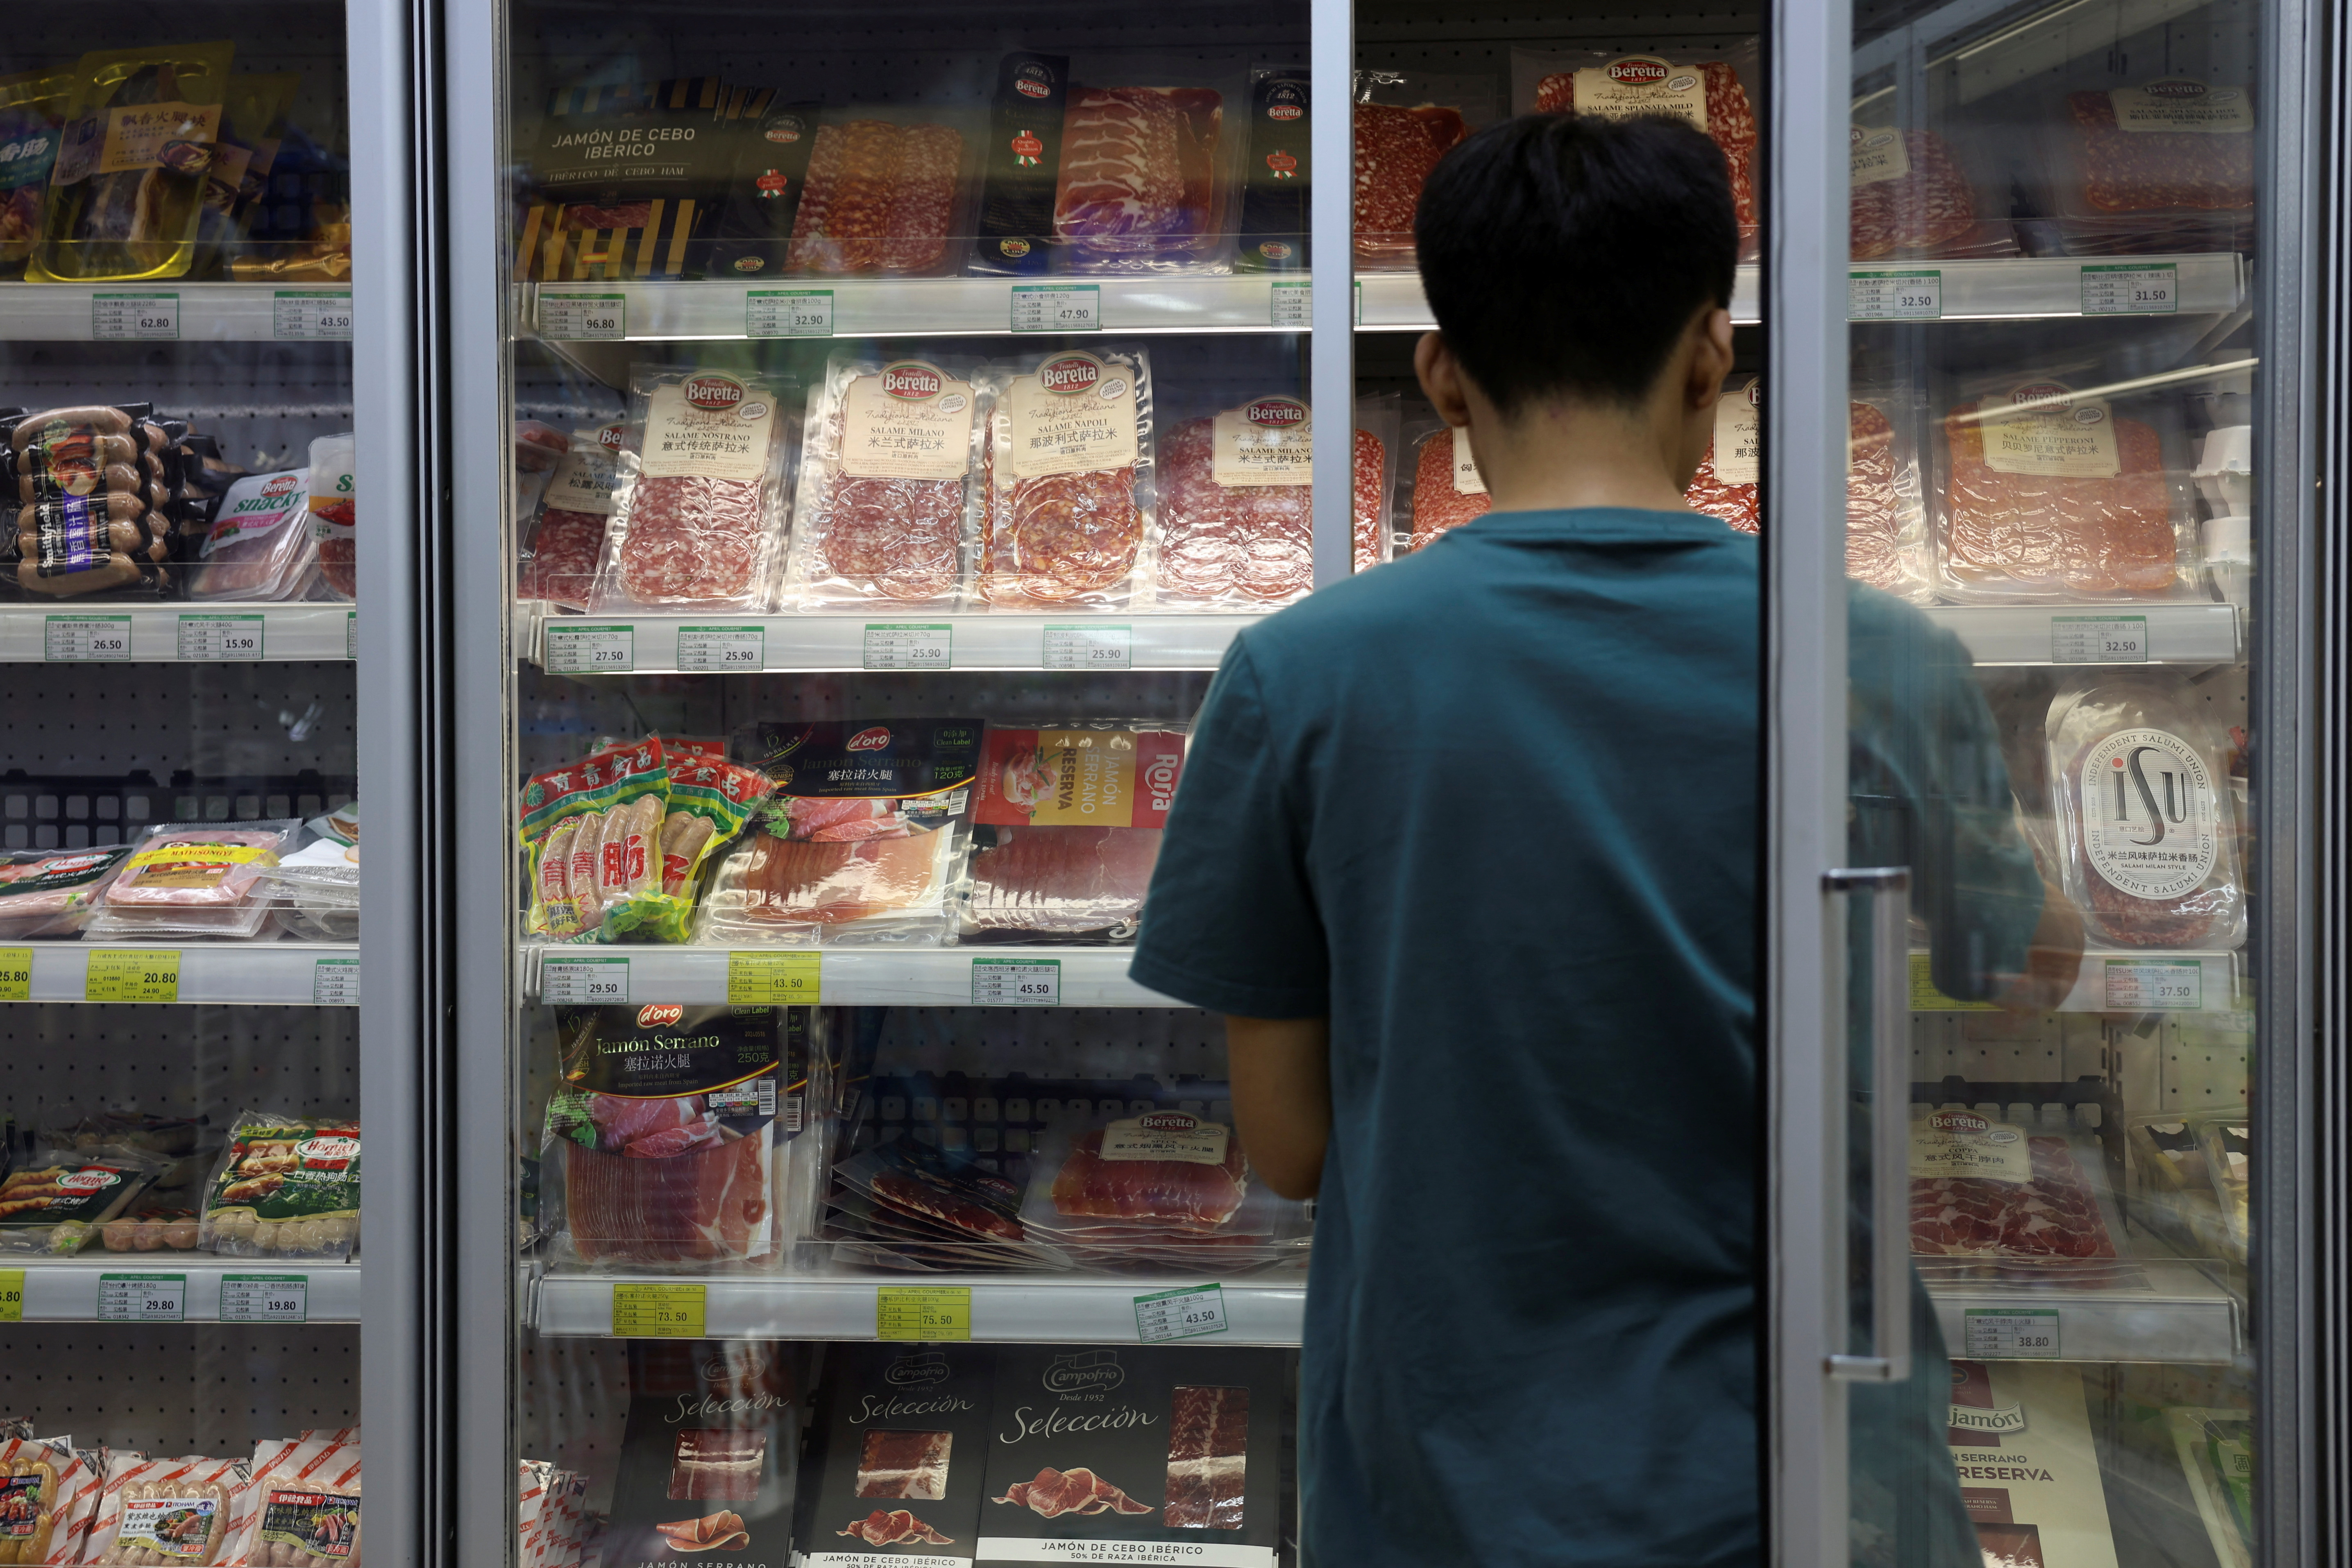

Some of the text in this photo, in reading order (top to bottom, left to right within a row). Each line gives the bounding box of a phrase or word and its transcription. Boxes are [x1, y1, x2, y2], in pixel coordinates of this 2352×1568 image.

[1610, 66, 1666, 78] Beretta
[1016, 80, 1049, 95] Beretta
[2146, 84, 2206, 95] Beretta
[1269, 108, 1301, 116] Beretta
[552, 128, 696, 148] JAMÓN DE CEBO
[766, 131, 800, 141] Beretta
[585, 141, 655, 159] IBÉRICO
[625, 167, 655, 176] CEBO
[661, 167, 684, 176] HAM
[2135, 290, 2166, 300] 31.50
[1901, 297, 1931, 306] 32.50
[795, 315, 823, 325] 32.90
[1060, 310, 1089, 319] 47.90
[141, 319, 168, 328] 62.80
[321, 317, 349, 326] 43.50
[587, 319, 615, 329] 96.80
[1043, 366, 1097, 387] Beretta
[885, 373, 939, 392] Beretta
[688, 383, 740, 401] Beretta
[1250, 407, 1304, 420] Beretta
[1038, 418, 1107, 434] SALAME NAPOLI
[702, 433, 750, 442] NOSTRANO
[870, 427, 944, 437] SALAME MILANO
[868, 436, 945, 451] 米兰式萨拉米
[1030, 428, 1118, 449] 那波利式萨拉米
[2003, 433, 2040, 443] SALAME
[661, 440, 750, 454] 意式传统萨拉米
[2002, 440, 2099, 455] 贝贝罗尼意式萨拉米
[1238, 454, 1312, 464] 米兰式萨拉米
[262, 479, 296, 494] Beretta
[234, 491, 307, 513] snacky
[40, 502, 57, 568] Smithfield
[93, 640, 121, 649] 26.50
[225, 639, 253, 648] 15.90
[2105, 642, 2136, 652] 32.50
[596, 652, 623, 661] 27.50
[726, 651, 753, 660] 25.90
[913, 648, 941, 658] 25.90
[1093, 650, 1121, 658] 25.90
[2089, 735, 2205, 790] INDEPENDENT SALUMI UNION
[556, 745, 652, 793] 育青食品
[827, 768, 893, 781] 塞拉诺火腿
[934, 770, 964, 779] 120克
[990, 761, 999, 777] Ready
[1057, 748, 1077, 810] RESERVA
[1080, 746, 1100, 814] SERRANO
[1102, 755, 1122, 805] JAMÓN
[543, 834, 644, 888] 育青肠
[2091, 830, 2209, 893] INDEPENDENT SALUMI UNION
[2107, 851, 2198, 863] 米兰风味萨拉米香肠
[144, 972, 176, 983] 20.80
[590, 983, 617, 992] 29.50
[1020, 984, 1049, 994] 45.50
[2159, 987, 2190, 997] 37.50
[640, 1006, 680, 1024] d'oro
[734, 1006, 769, 1015] Clean Label
[595, 1034, 720, 1056] Jamón Serrano
[624, 1053, 691, 1072] 塞拉诺火腿
[737, 1052, 770, 1064] 250克
[683, 1078, 699, 1086] Spain
[1142, 1117, 1195, 1128] Beretta
[1931, 1117, 1987, 1130] Beretta
[307, 1141, 356, 1151] Hormel
[1114, 1143, 1214, 1153] 意式烟熏风干火腿
[1925, 1153, 2004, 1164] 意式风干脖肉
[284, 1171, 348, 1181] 一口香热狗肠
[146, 1301, 174, 1310] 29.80
[268, 1301, 296, 1310] 19.80
[1186, 1310, 1215, 1324] 43.50
[2019, 1337, 2049, 1347] 38.80
[1084, 1394, 1105, 1402] 1952
[663, 1391, 790, 1423] Selección
[849, 1394, 975, 1424] Selección
[999, 1405, 1159, 1445] Selección
[1961, 1453, 2028, 1464] SERRANO
[1957, 1466, 2055, 1482] RESERVA
[279, 1494, 313, 1504] 伊藤食品
[1041, 1541, 1204, 1555] JAMÓN DE CEBO IBÉRICO
[823, 1554, 860, 1563] JAMÓN
[881, 1556, 910, 1564] CEBO
[913, 1556, 956, 1566] IBÉRICO
[1137, 1553, 1177, 1562] IBÉRICA
